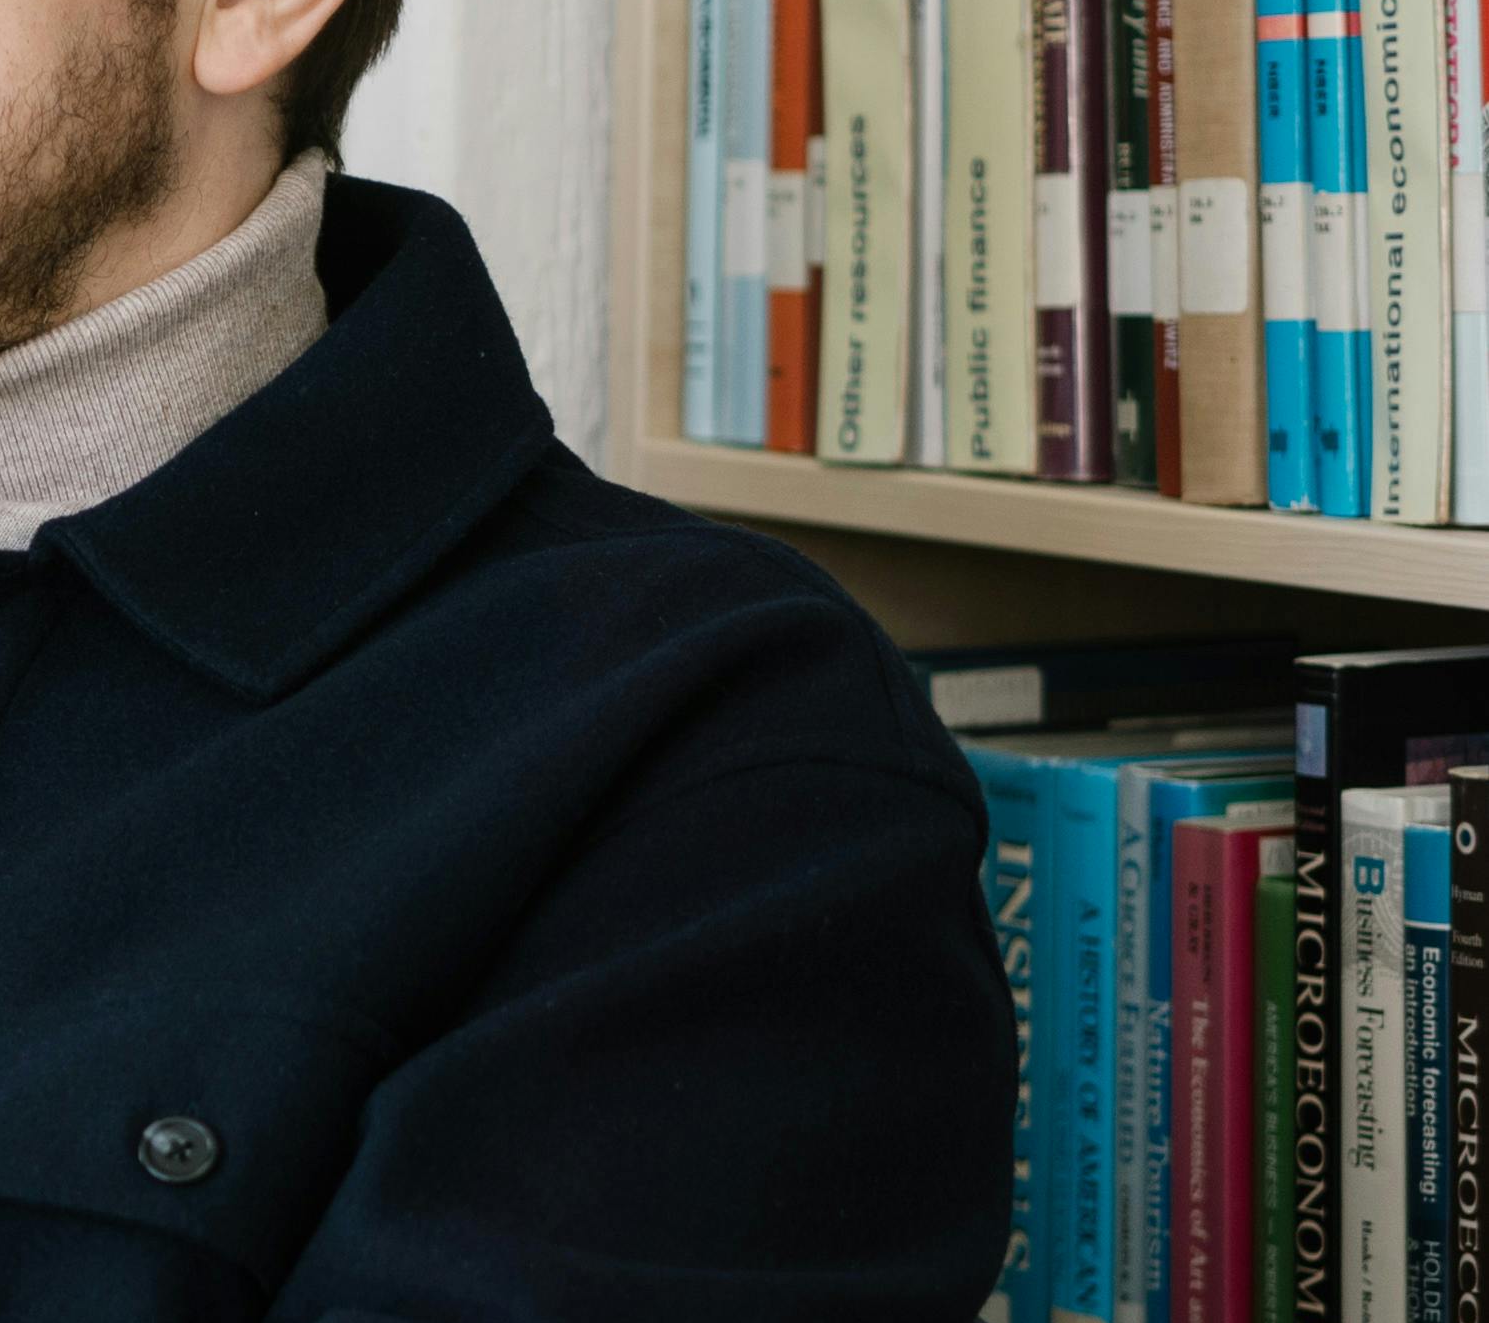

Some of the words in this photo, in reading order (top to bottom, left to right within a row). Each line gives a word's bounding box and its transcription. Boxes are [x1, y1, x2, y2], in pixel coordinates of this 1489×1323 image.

[1268, 59, 1282, 119] NBER
[1314, 58, 1328, 118] NBER
[849, 113, 869, 324] resources
[966, 156, 989, 317] finance
[838, 336, 868, 453] Other
[968, 328, 994, 461] Public
[1383, 229, 1407, 517] International
[1079, 901, 1100, 925] A
[1353, 855, 1386, 999] Business
[1451, 882, 1484, 903] Hyman
[1451, 930, 1483, 948] Fourth
[1078, 933, 1101, 1066] HISTORY
[1404, 942, 1416, 969] an
[1421, 945, 1441, 1059] Economic
[1450, 951, 1485, 970] Edition
[1146, 998, 1172, 1128] Nature
[1190, 999, 1212, 1038] The
[1404, 977, 1416, 1117] introduction
[1079, 1075, 1101, 1124] OF
[1189, 1052, 1211, 1201] Economics
[1349, 1004, 1385, 1173] Forecasting
[1419, 1063, 1440, 1205] forecasting:
[1078, 1131, 1102, 1310] AMERICAN
[1144, 1131, 1171, 1291] Tourism
[1188, 1206, 1209, 1239] of
[1188, 1243, 1208, 1292] Art
